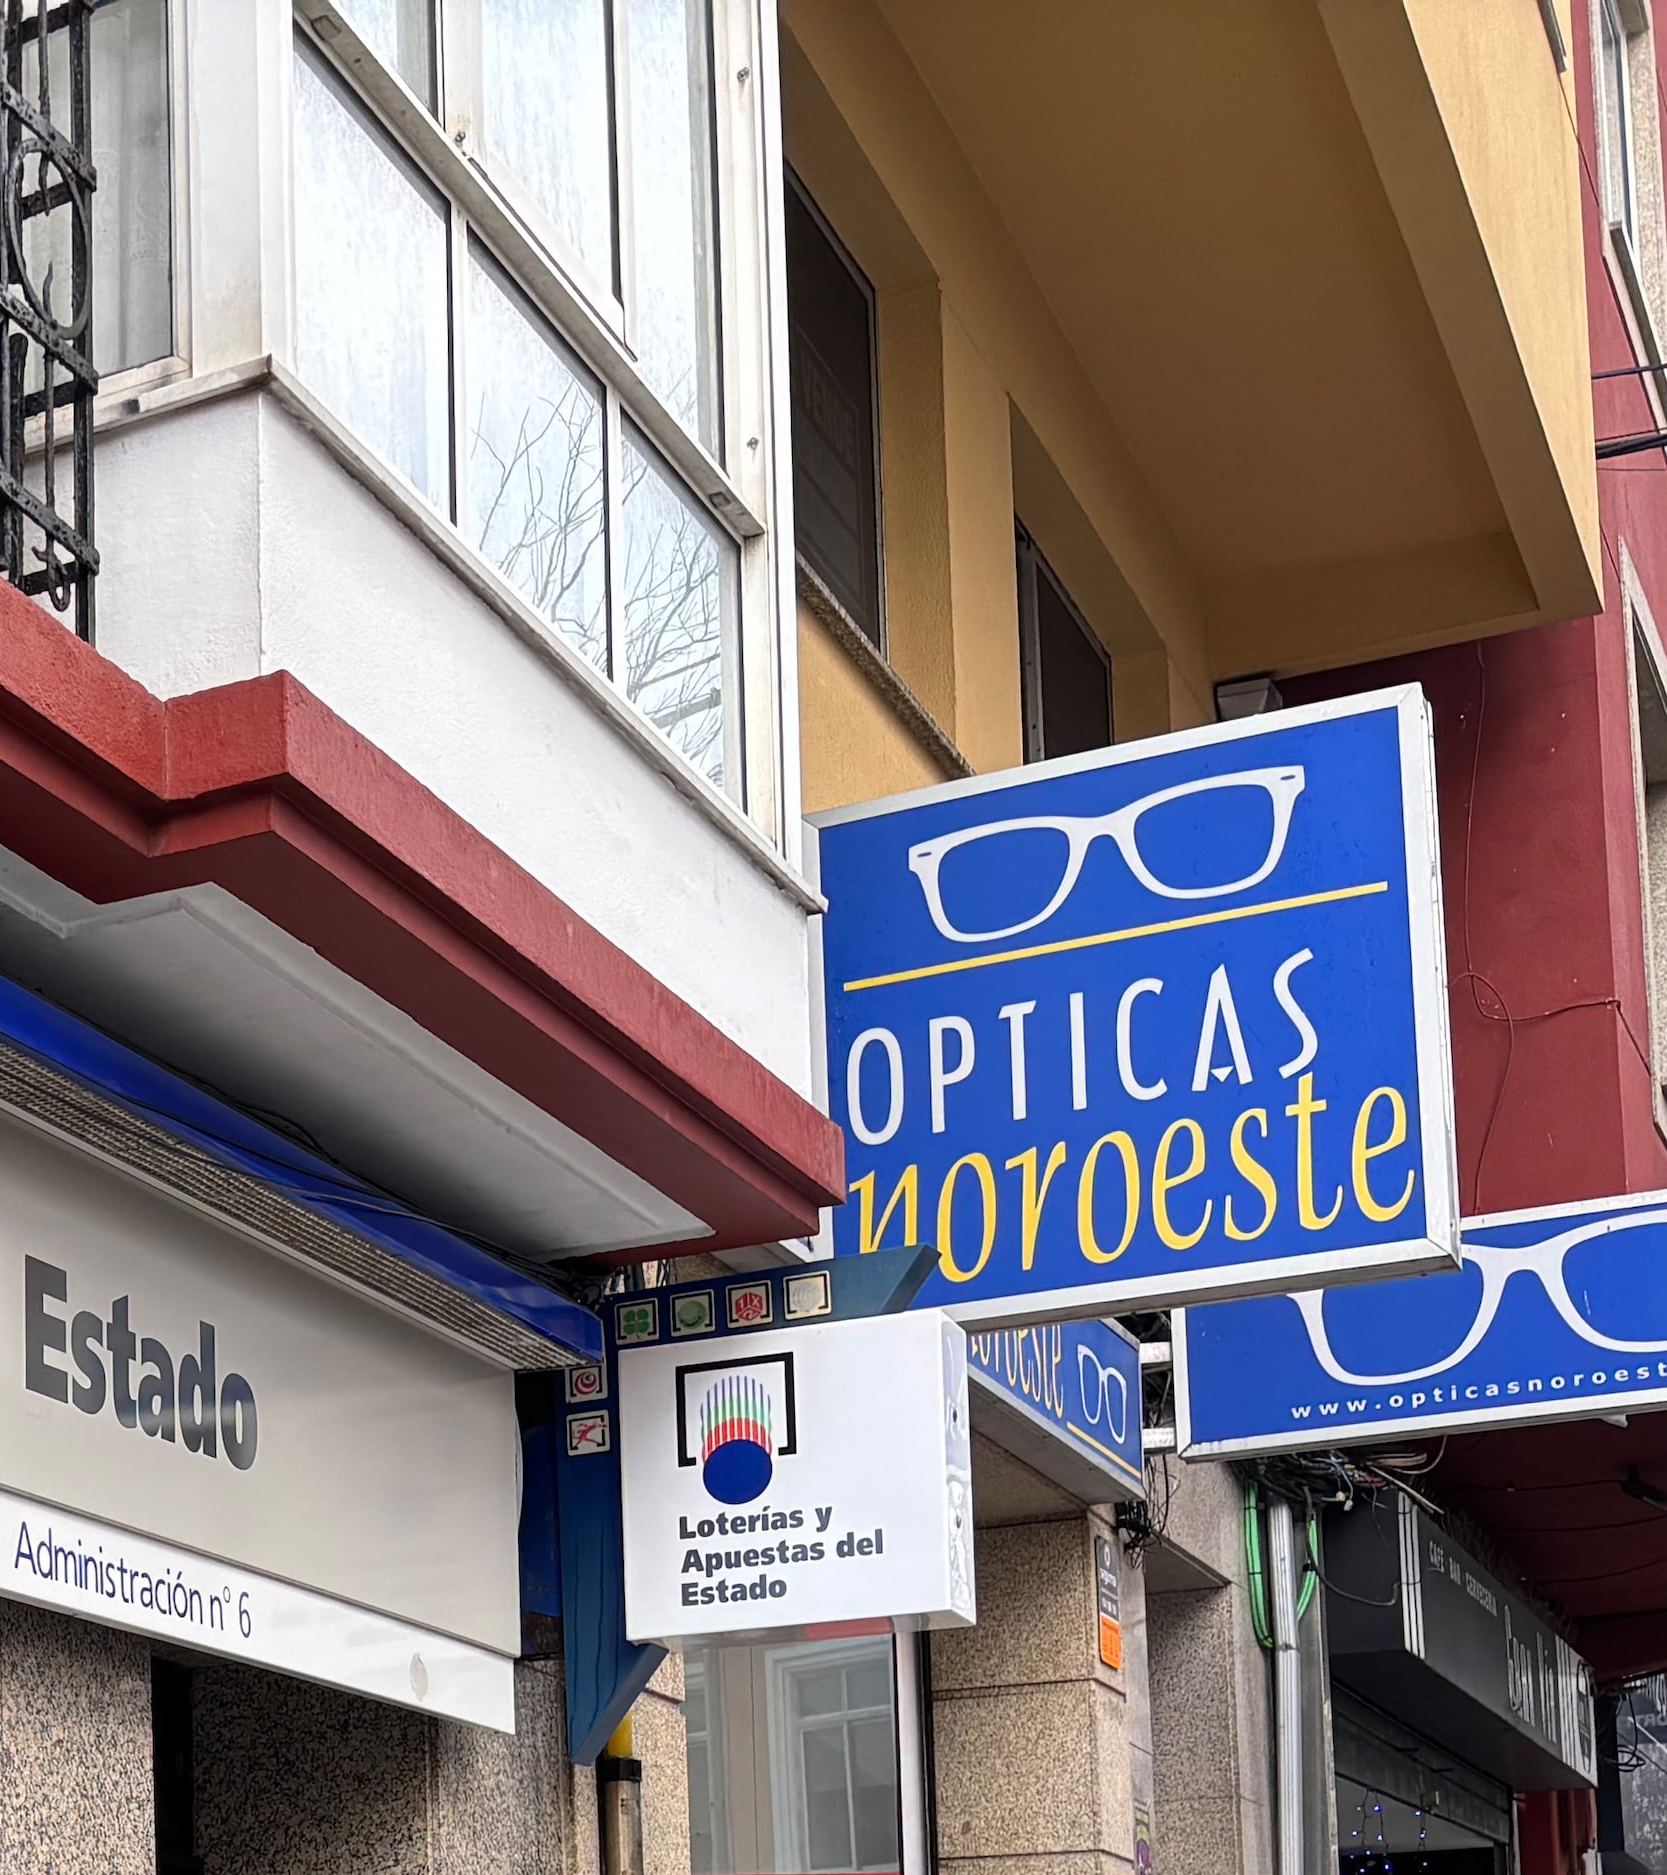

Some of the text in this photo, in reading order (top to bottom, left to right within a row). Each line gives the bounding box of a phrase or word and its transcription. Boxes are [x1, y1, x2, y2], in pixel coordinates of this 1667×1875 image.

[846, 947, 1316, 1146] OPTICAS
[848, 1074, 1414, 1284] noroeste
[25, 1254, 258, 1471] Estado
[14, 1520, 204, 1624] Administración
[239, 1591, 252, 1639] 6
[679, 1506, 833, 1539] Loterías y
[681, 1528, 884, 1577] Apuestas del
[681, 1575, 788, 1607] Estado
